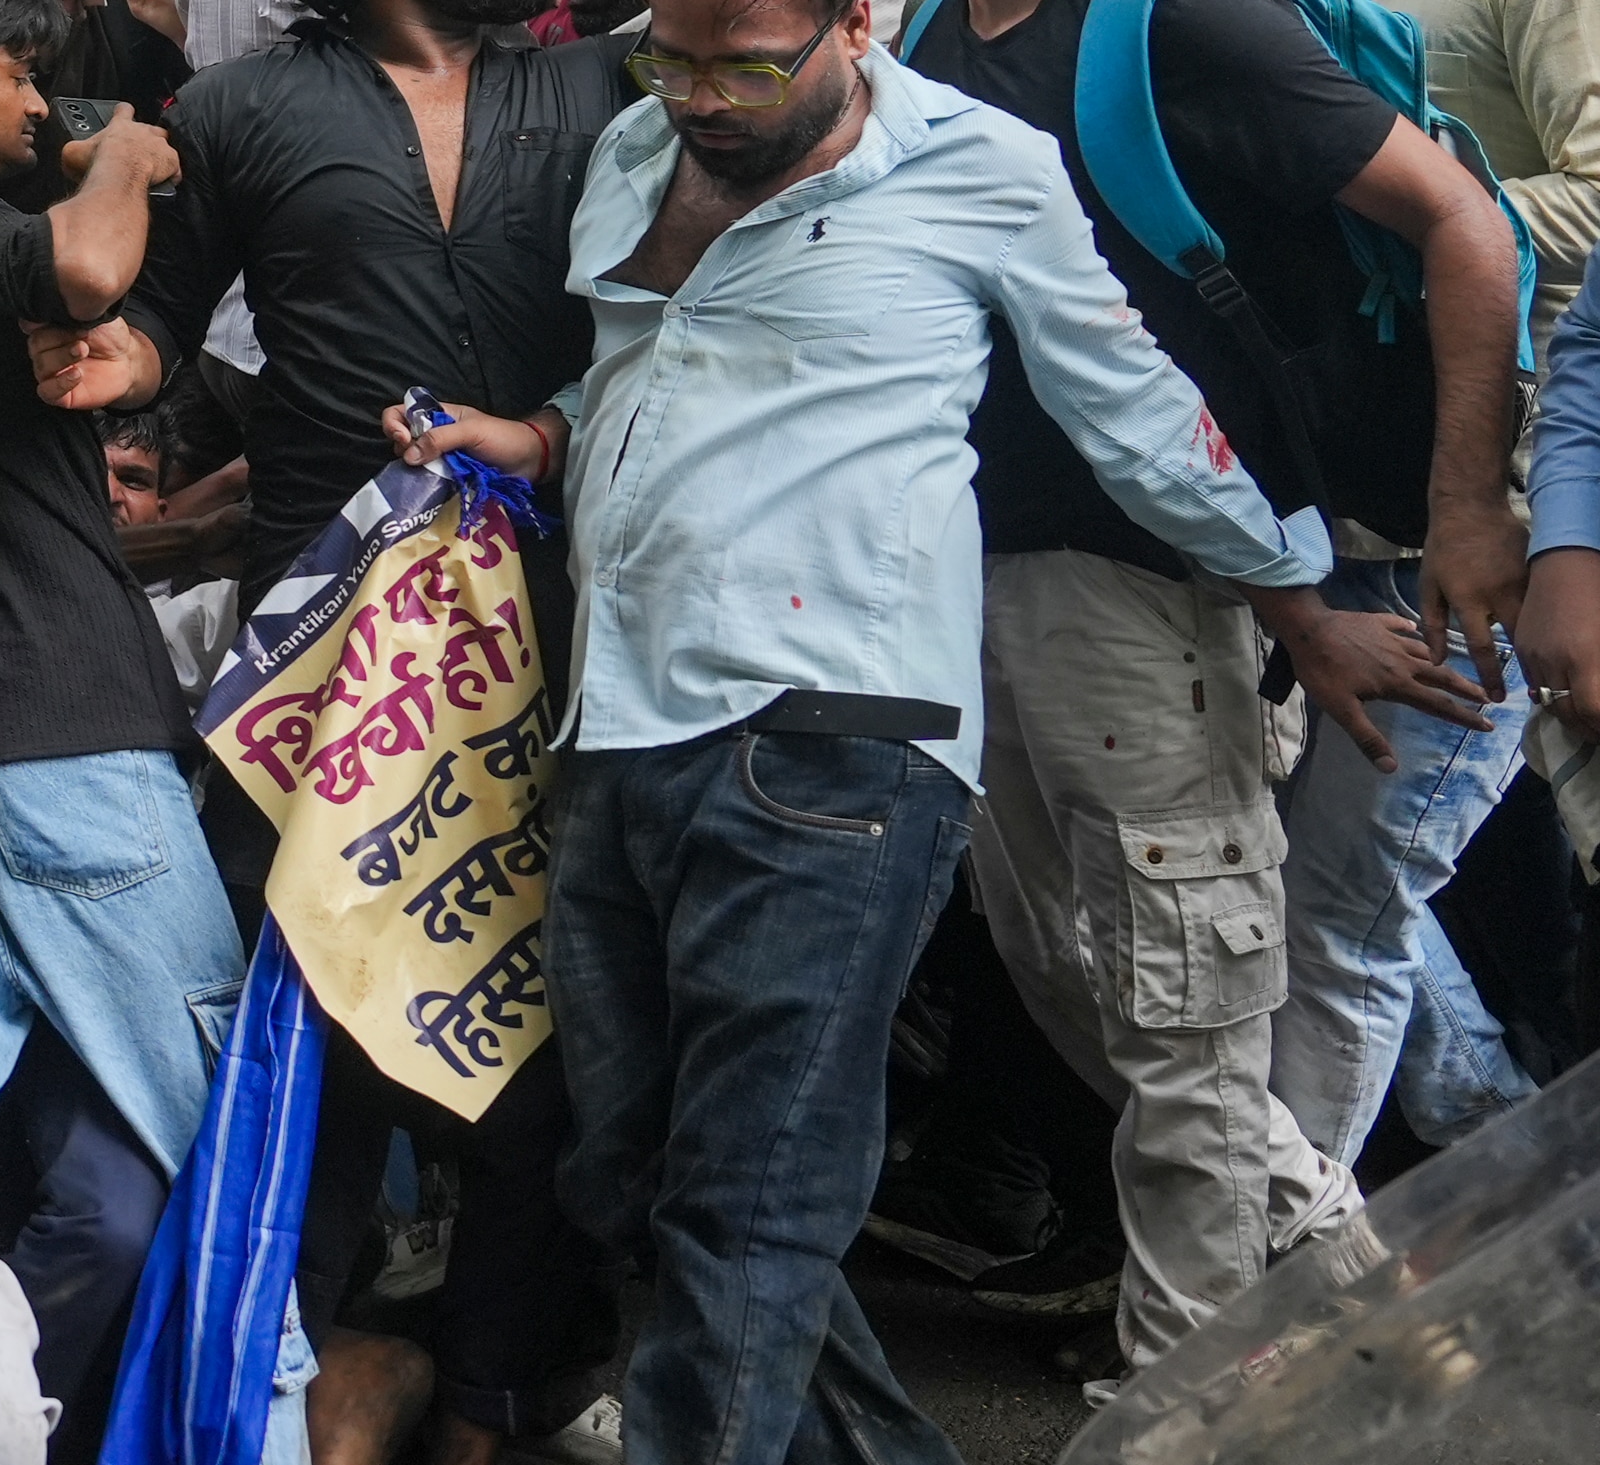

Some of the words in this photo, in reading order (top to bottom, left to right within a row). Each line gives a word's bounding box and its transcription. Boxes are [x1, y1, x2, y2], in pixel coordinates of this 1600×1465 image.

[254, 584, 349, 675] Krantikari
[346, 538, 381, 584] Yuva
[383, 545, 461, 625] पर
[302, 651, 435, 804] खर्चा
[436, 596, 531, 711] हो!
[341, 749, 473, 887] बजट
[462, 687, 554, 780] का
